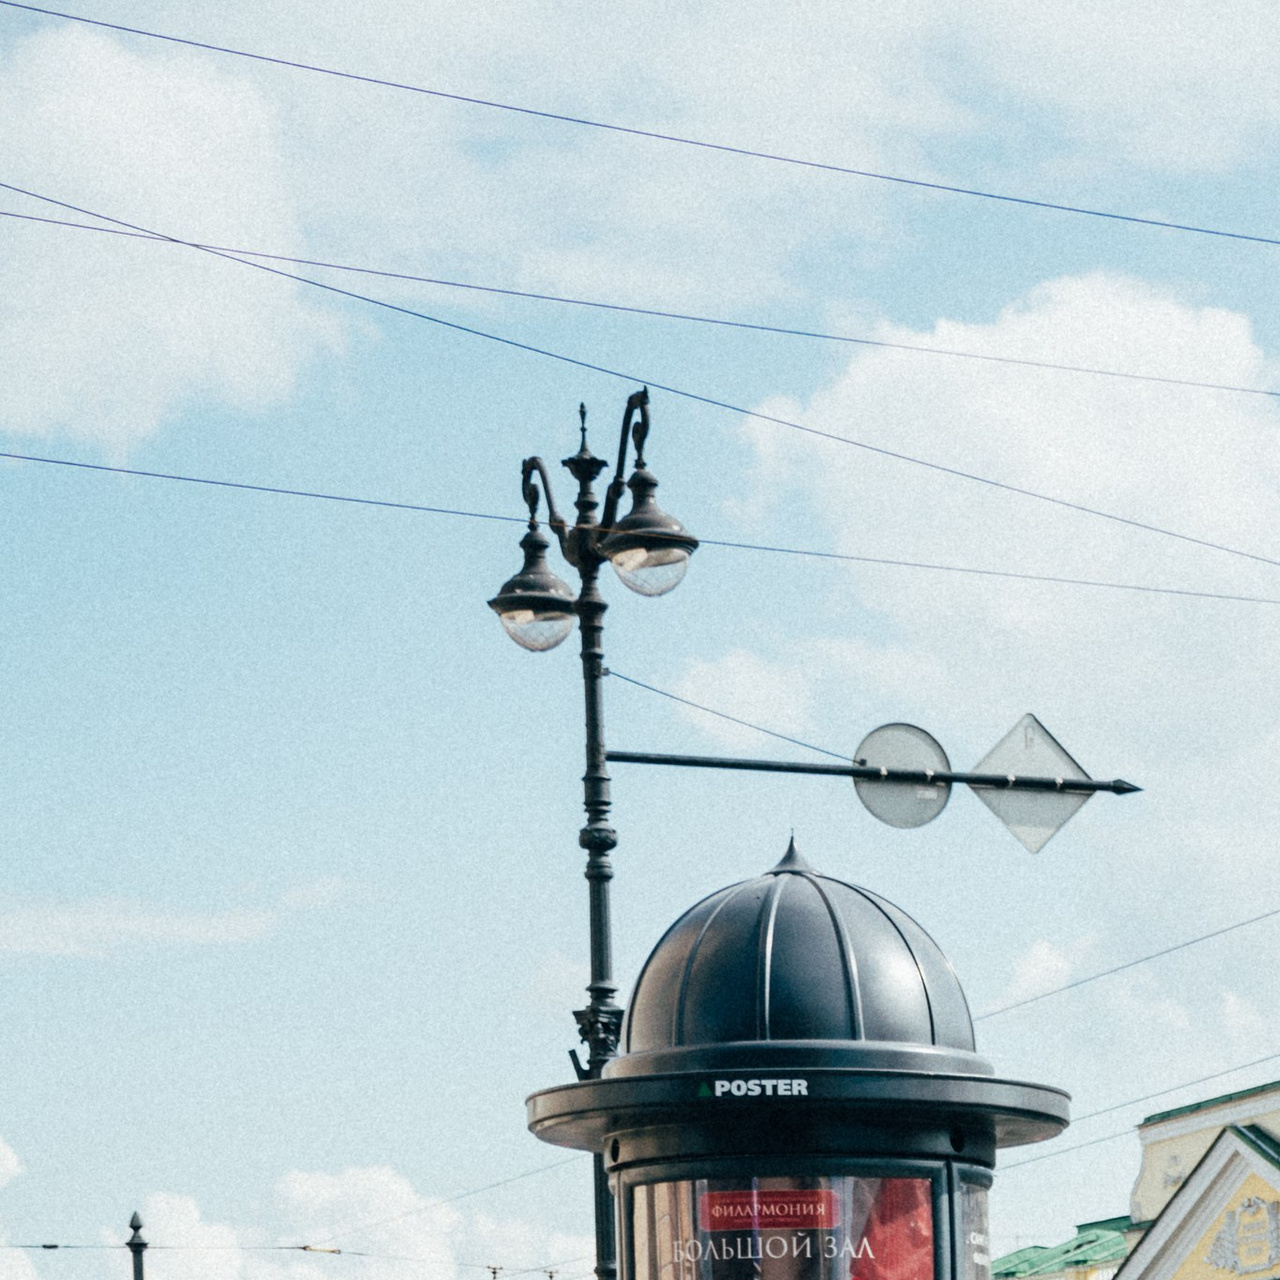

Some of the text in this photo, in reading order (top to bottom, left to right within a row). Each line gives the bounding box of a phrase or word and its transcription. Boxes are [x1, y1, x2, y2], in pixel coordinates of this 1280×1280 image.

[715, 1079, 808, 1097] POSTER
[711, 1203, 826, 1218] ФИЛАРМОНИЯ
[673, 1232, 875, 1262] БОЛЬШОЙ ЗАЛ
